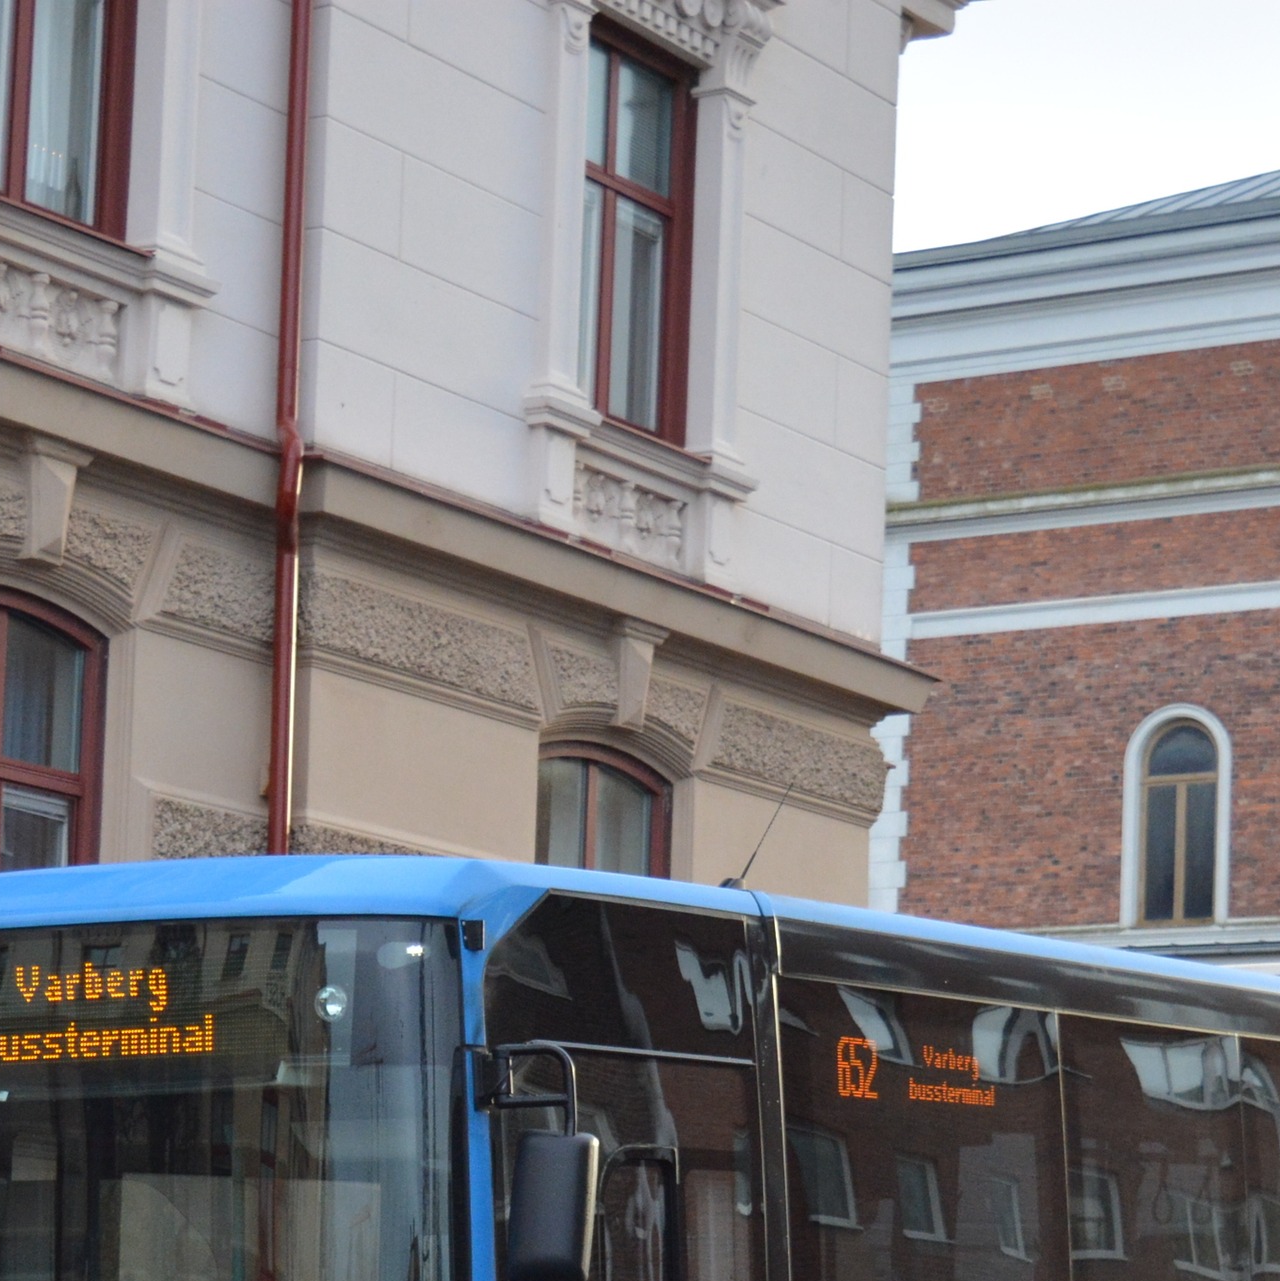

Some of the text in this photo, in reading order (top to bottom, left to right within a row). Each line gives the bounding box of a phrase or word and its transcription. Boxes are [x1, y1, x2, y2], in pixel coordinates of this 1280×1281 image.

[16, 963, 168, 1012] Varberg
[837, 1036, 878, 1098] 652
[923, 1045, 980, 1081] Varberg
[908, 1077, 995, 1106] bussterminal
